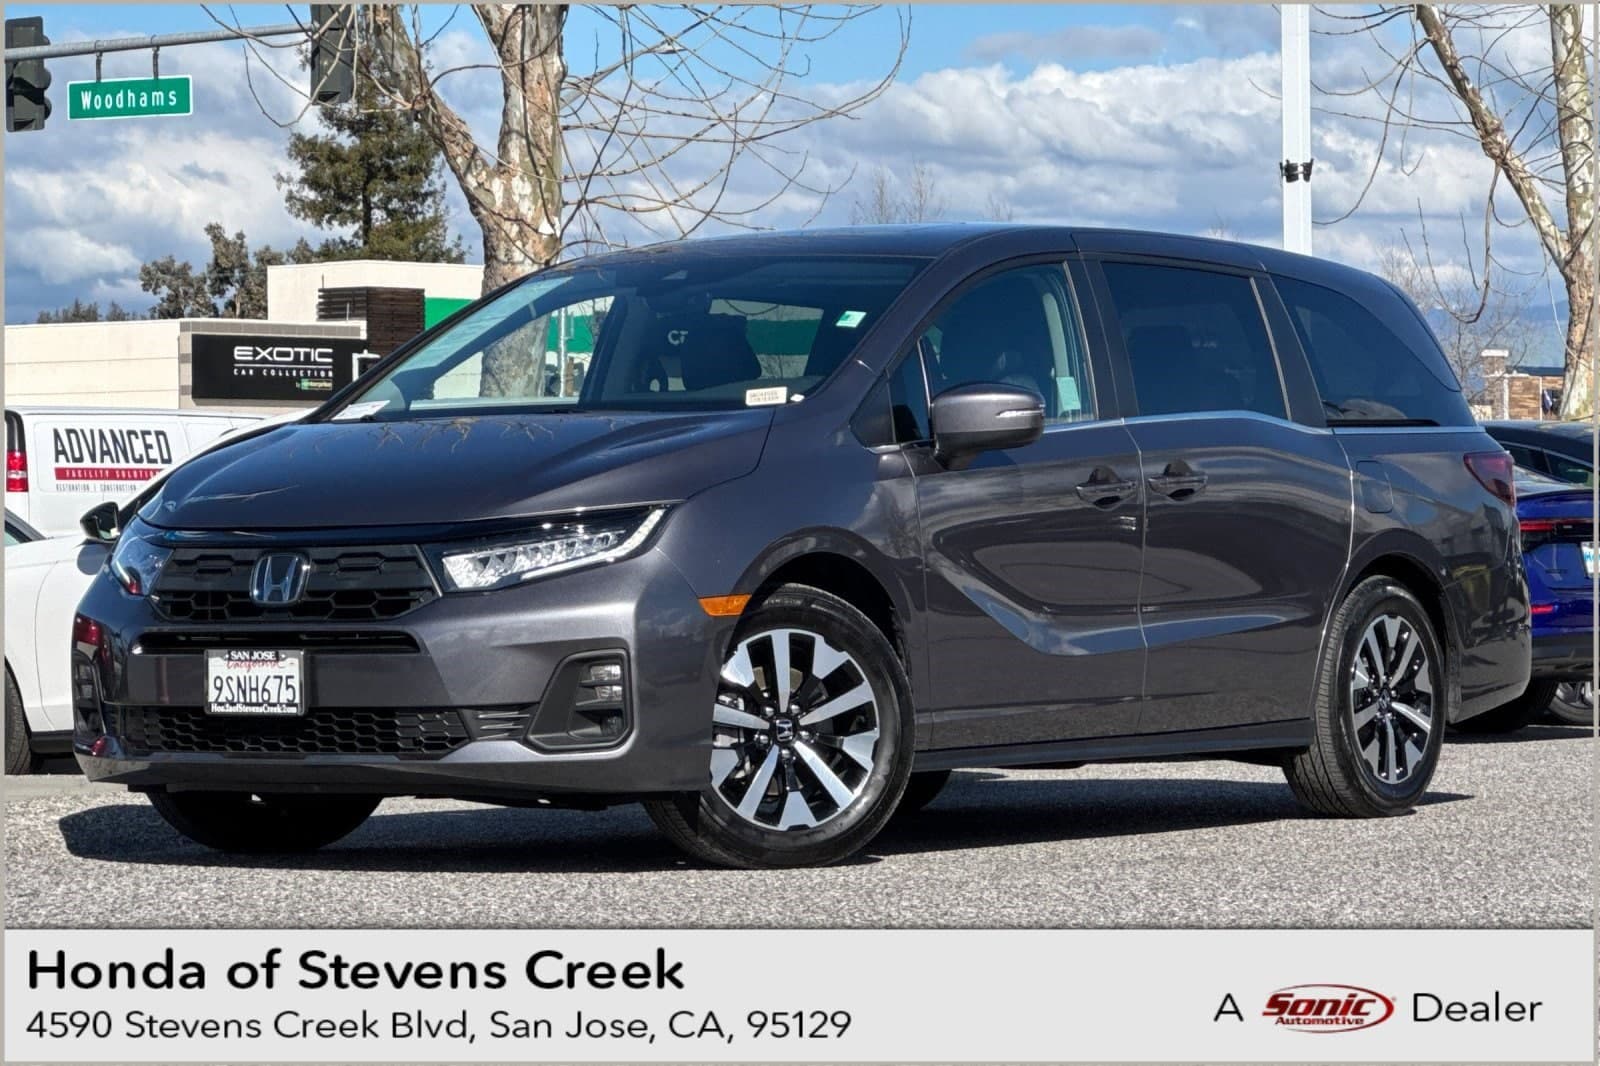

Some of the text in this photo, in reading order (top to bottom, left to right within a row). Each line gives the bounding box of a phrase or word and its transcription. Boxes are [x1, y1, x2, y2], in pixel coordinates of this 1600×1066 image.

[81, 89, 177, 111] Woodhams
[233, 346, 333, 363] EXOTIC
[233, 368, 333, 378] CAR COLLECTION
[53, 428, 172, 464] ADVANCED
[65, 469, 109, 478] FACILITY
[230, 650, 277, 660] SAN JOSE
[213, 675, 296, 703] 9SNH675
